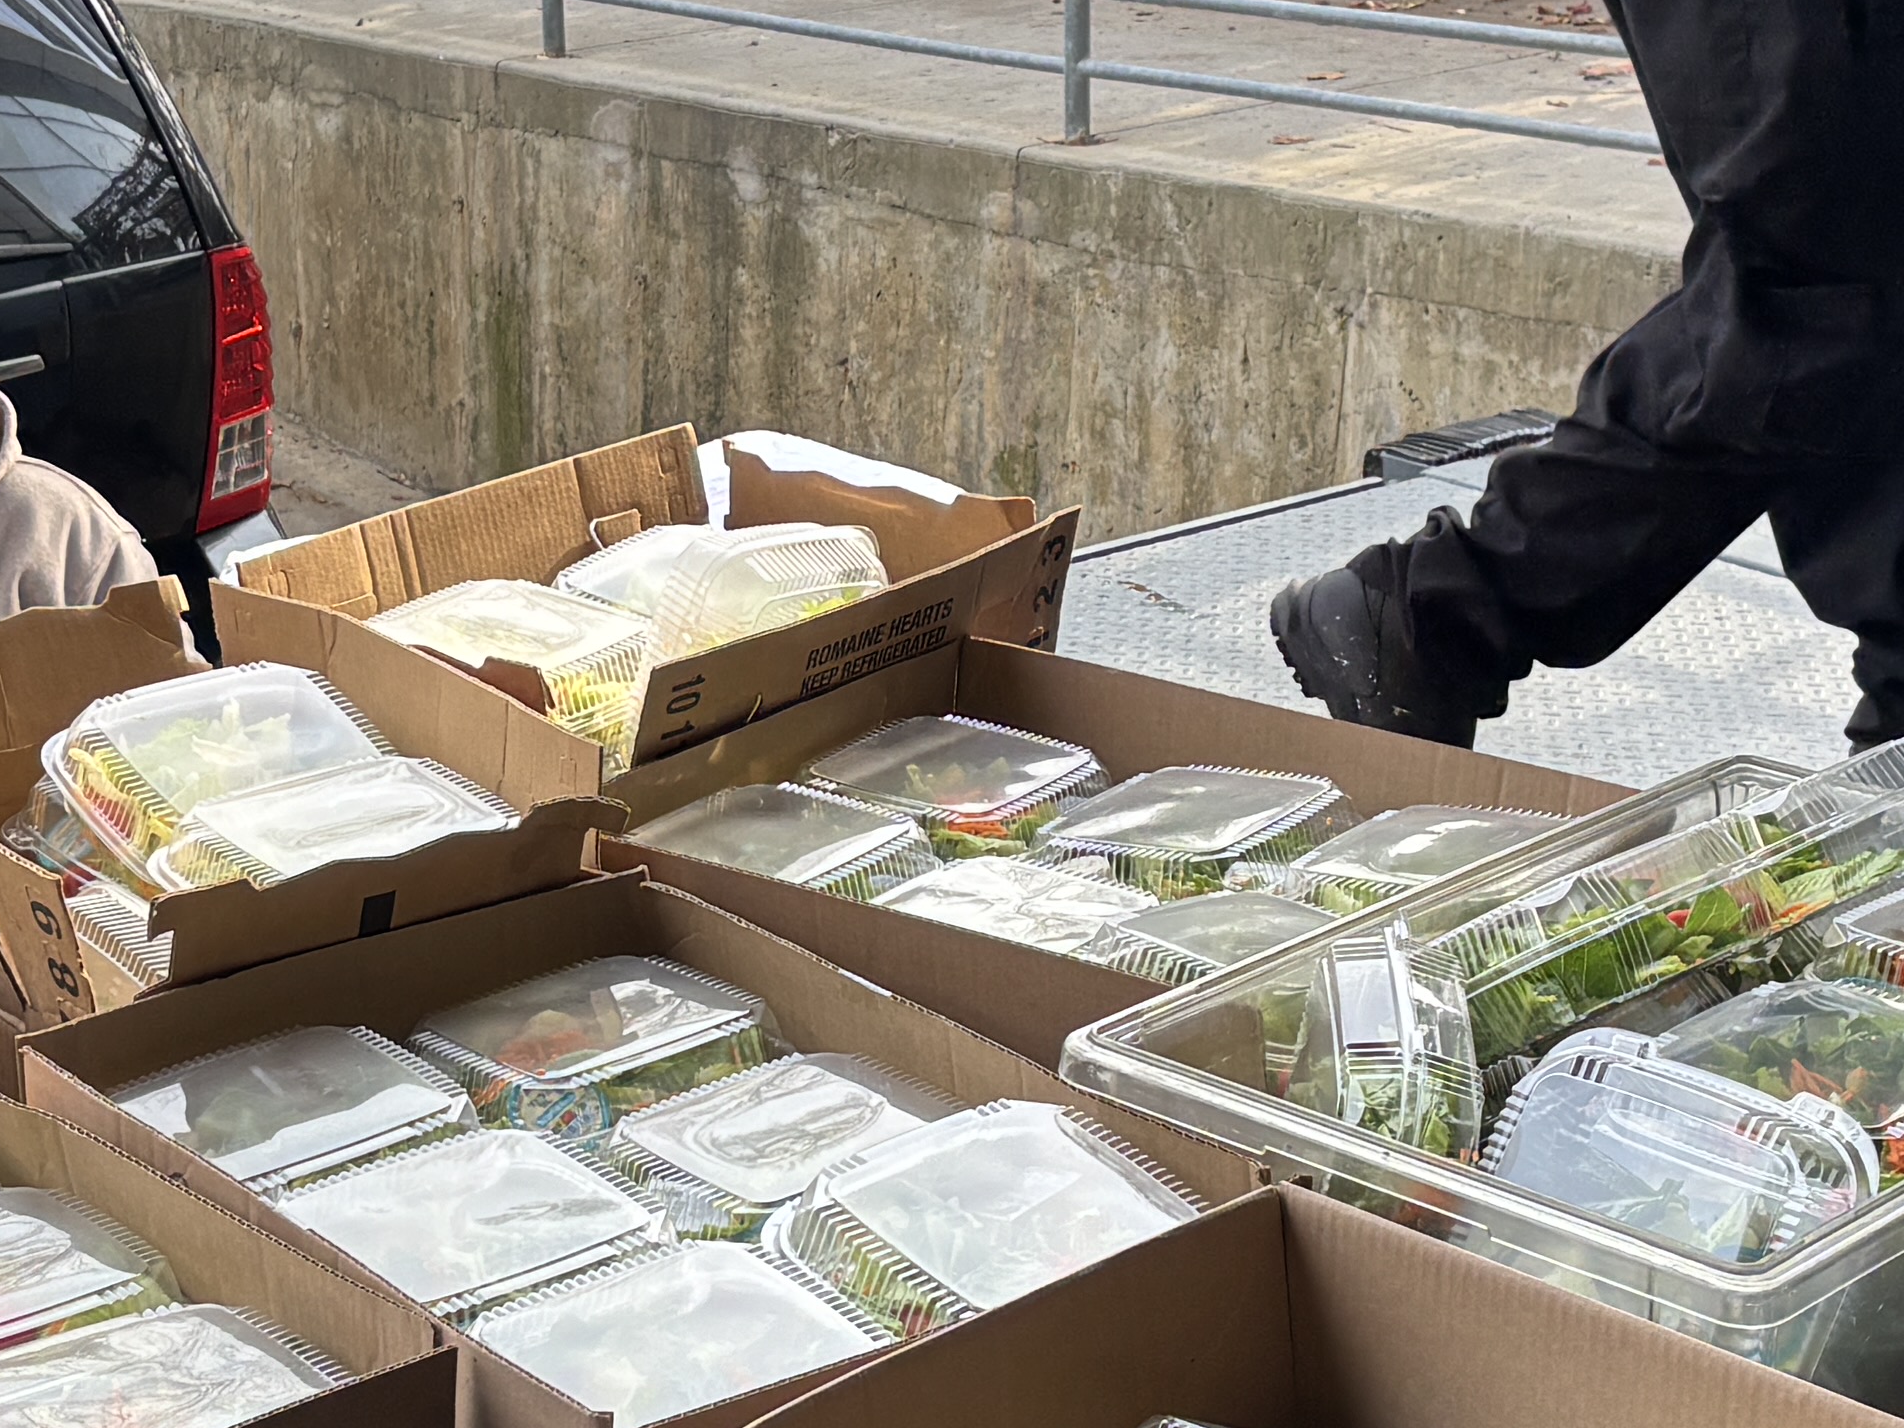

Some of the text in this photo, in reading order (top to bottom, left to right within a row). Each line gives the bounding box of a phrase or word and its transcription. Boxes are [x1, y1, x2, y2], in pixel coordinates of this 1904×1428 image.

[800, 625, 947, 697] KEEP REFRIGERATED
[806, 597, 954, 672] ROMAINE HEARTS
[47, 956, 80, 998] 8
